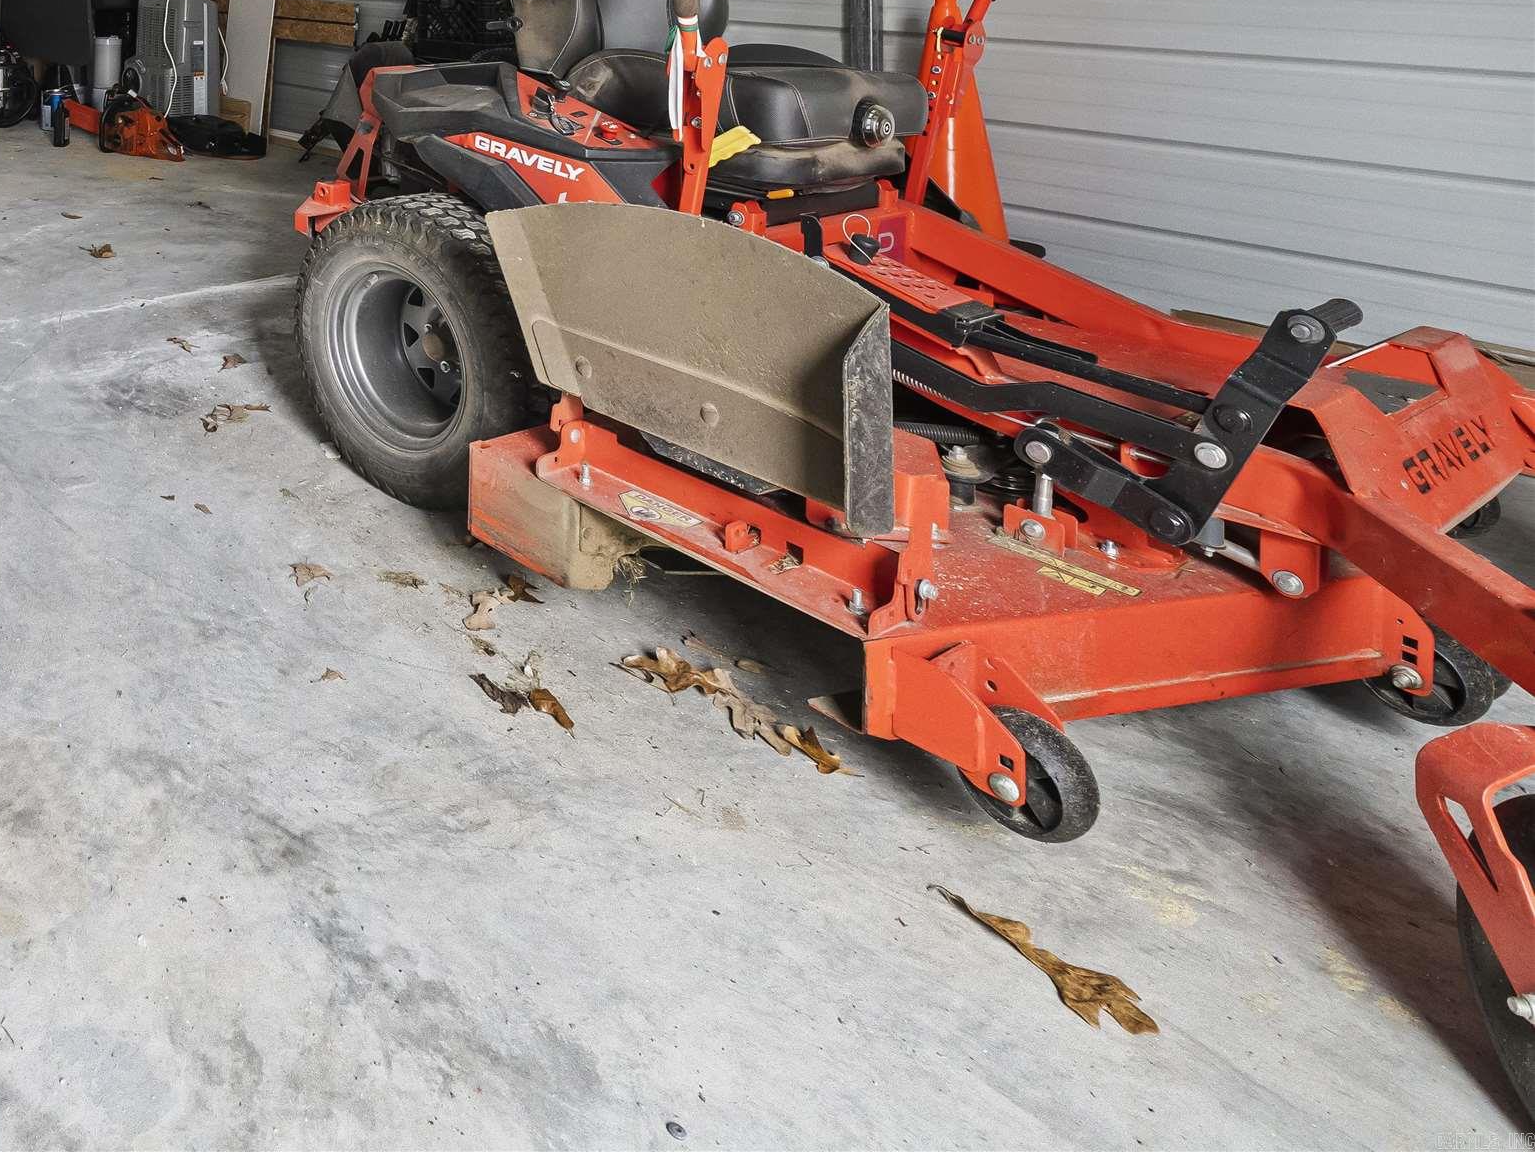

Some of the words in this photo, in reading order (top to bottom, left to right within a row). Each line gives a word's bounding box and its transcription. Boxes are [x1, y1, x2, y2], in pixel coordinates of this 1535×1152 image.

[474, 134, 585, 181] GRAVELY
[1402, 415, 1497, 494] GRAVELY
[634, 494, 692, 521] DANGER
